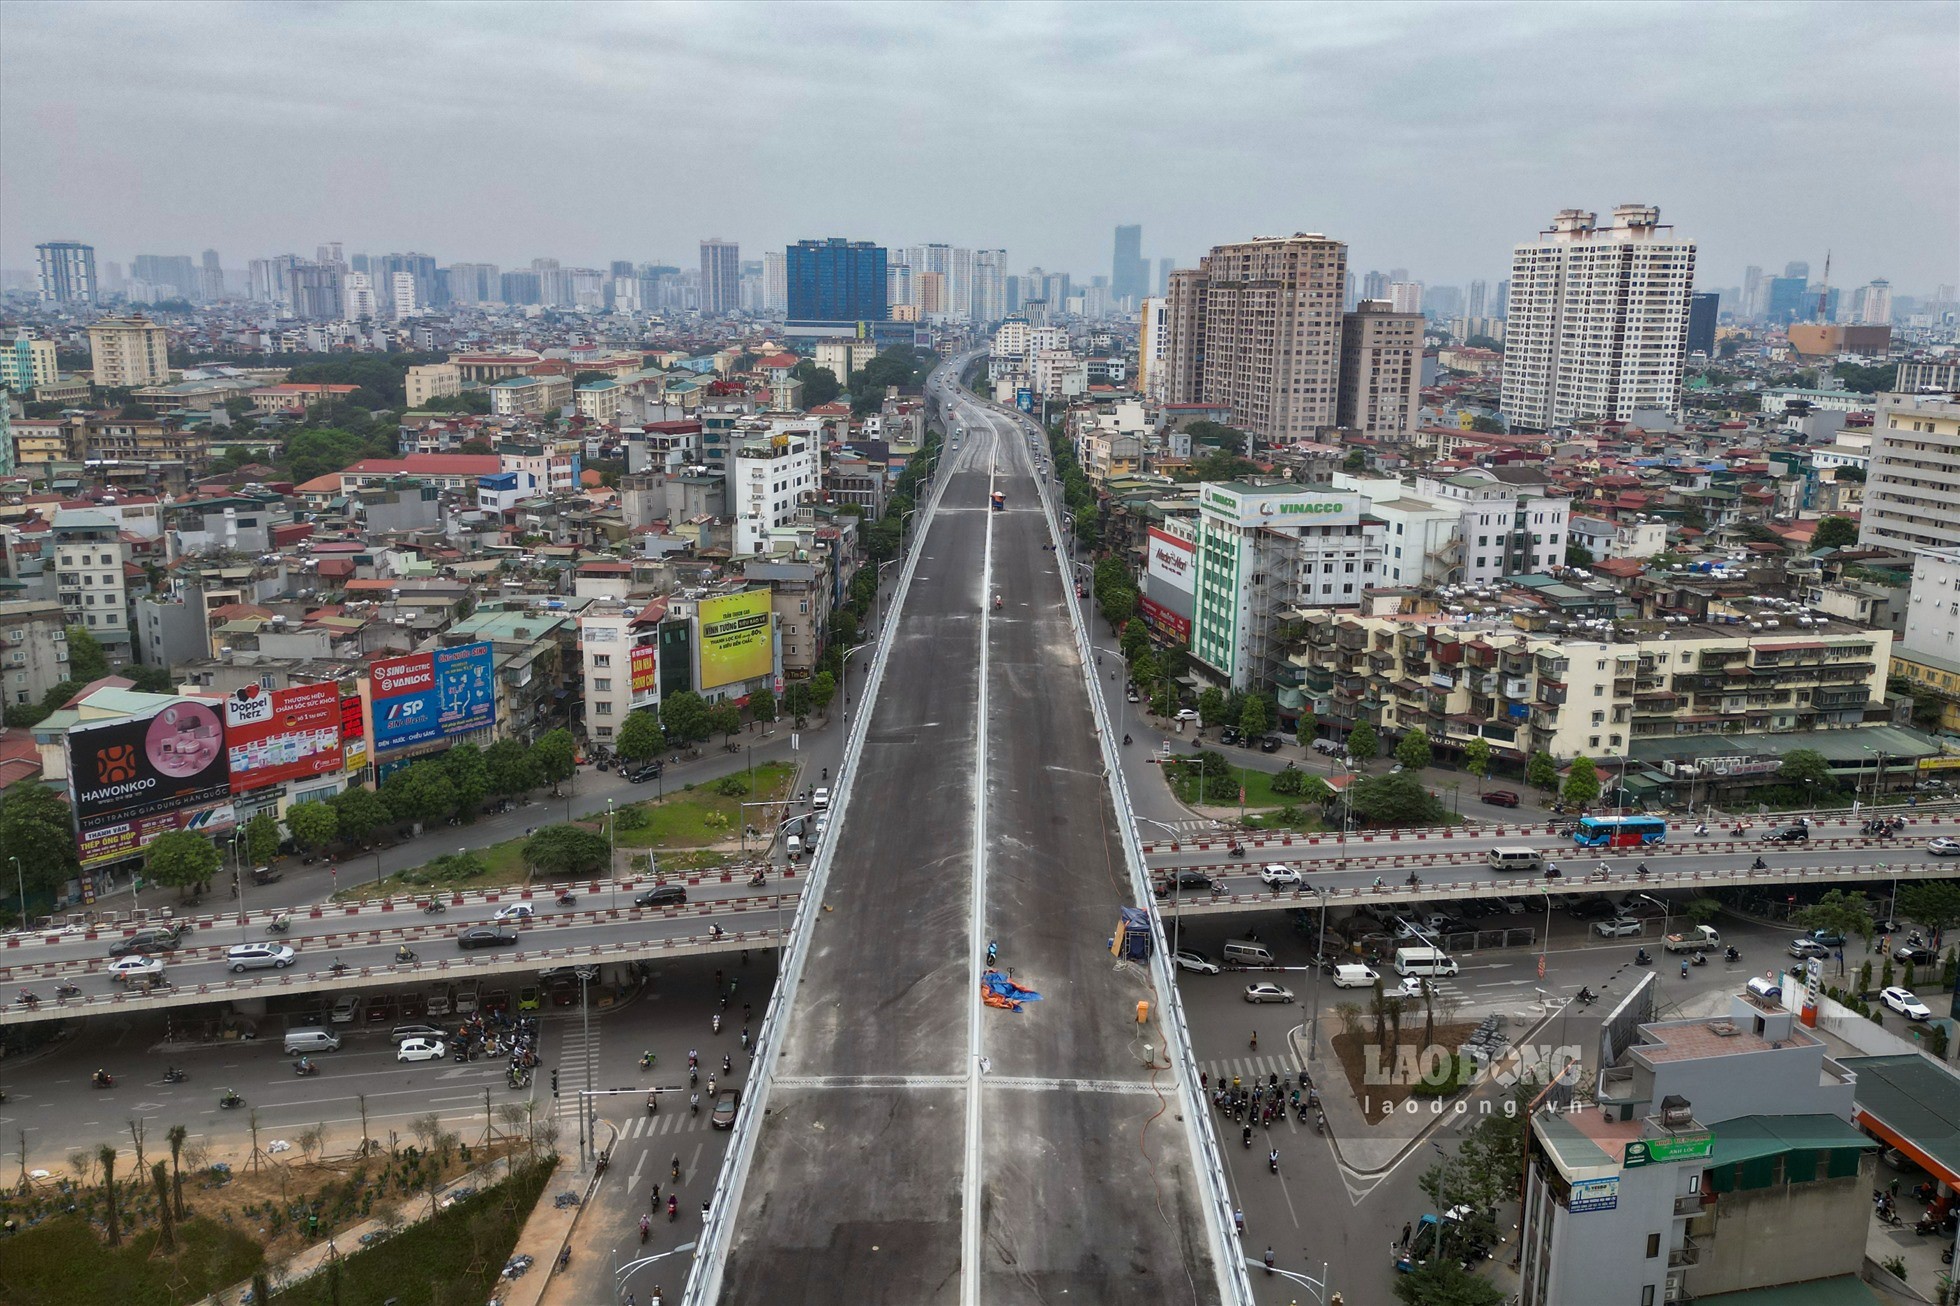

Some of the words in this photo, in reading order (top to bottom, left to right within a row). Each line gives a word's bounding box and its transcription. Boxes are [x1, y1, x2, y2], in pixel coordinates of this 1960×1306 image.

[1212, 492, 1237, 509] VINACCO
[1279, 503, 1343, 514] VINACCO
[471, 646, 488, 656] SINO
[386, 665, 405, 677] SINO
[405, 663, 430, 673] ELECTRIC
[393, 673, 431, 688] VANLOCK
[230, 697, 267, 713] Doppel
[402, 699, 424, 716] SP
[239, 709, 261, 720] herz
[81, 777, 156, 803] HAWONKOO
[107, 809, 137, 822] TRANG
[138, 805, 156, 815] GIA
[202, 787, 229, 800] QUỐC
[80, 838, 100, 851] THÉP
[101, 835, 119, 846] ỐNG
[120, 831, 136, 843] HỘP
